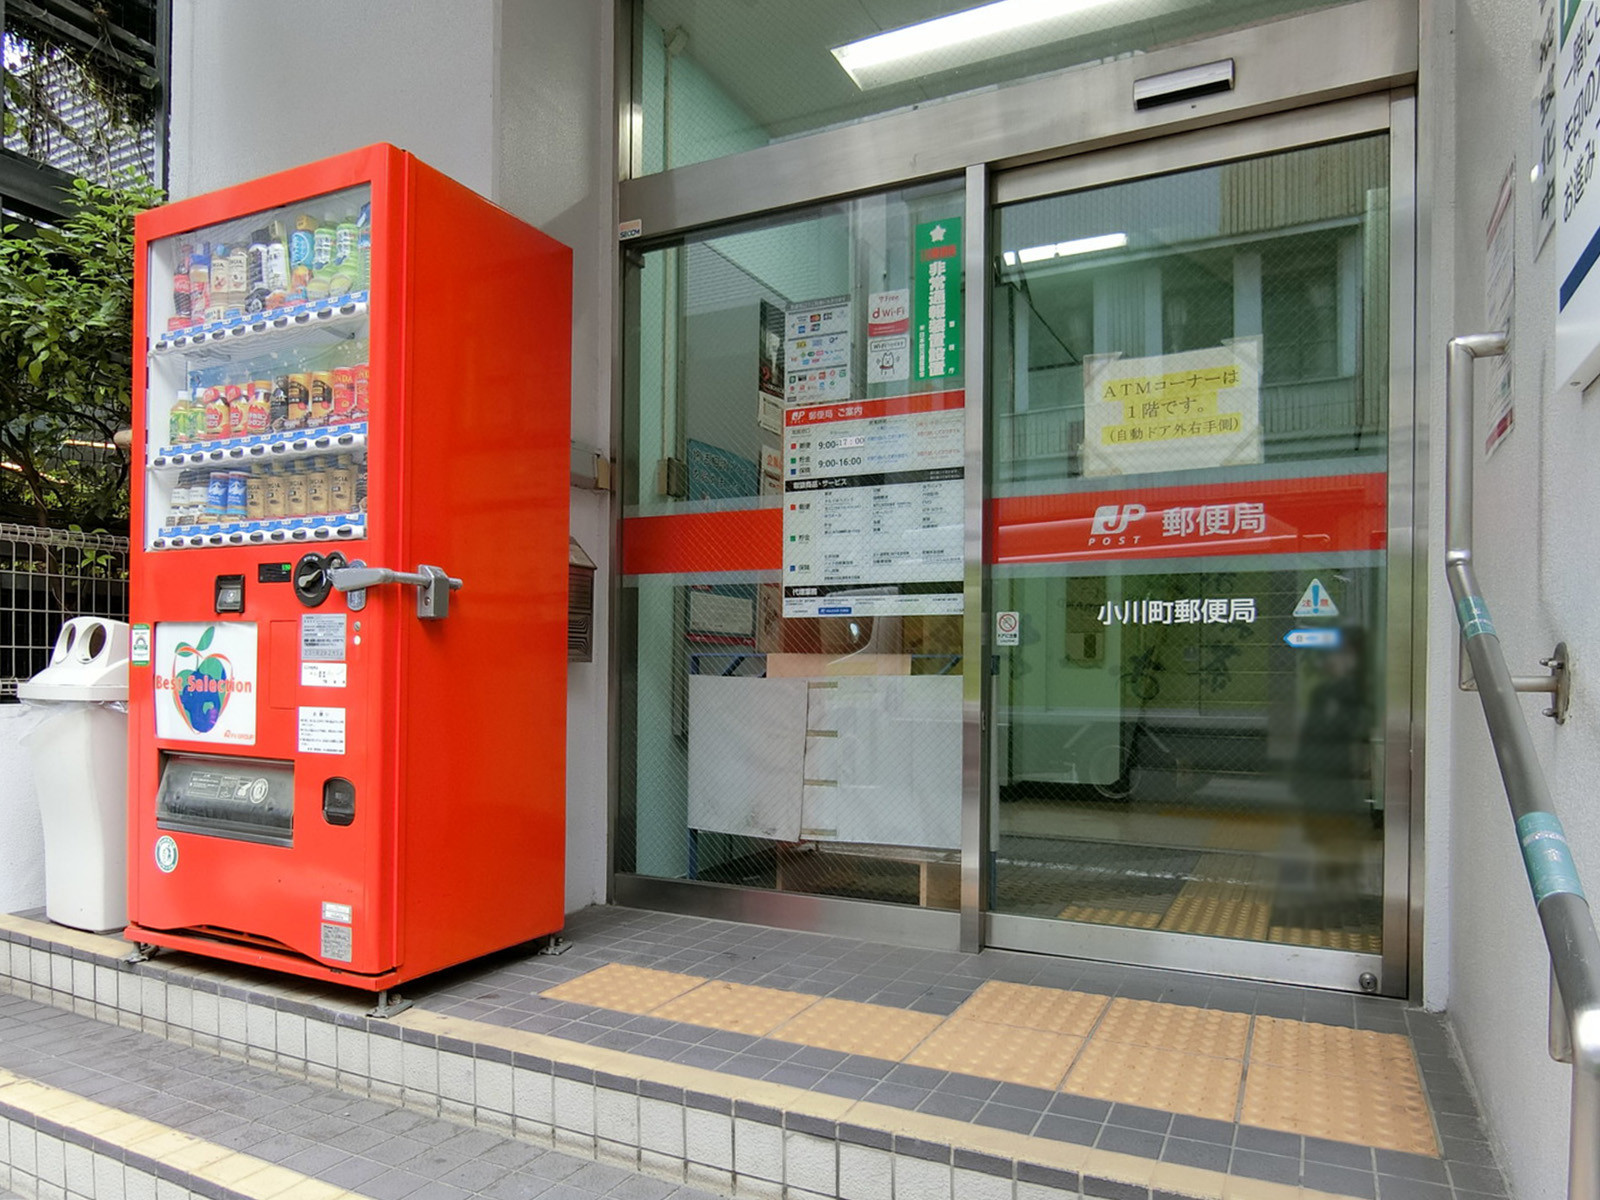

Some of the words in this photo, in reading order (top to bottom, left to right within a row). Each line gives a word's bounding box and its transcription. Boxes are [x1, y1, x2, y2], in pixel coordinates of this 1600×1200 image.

[1162, 502, 1267, 538] 郵便局
[1087, 535, 1141, 547] POST
[1096, 598, 1257, 626] 小川町郵便局
[155, 674, 184, 691] Best
[187, 674, 253, 694] Selection
